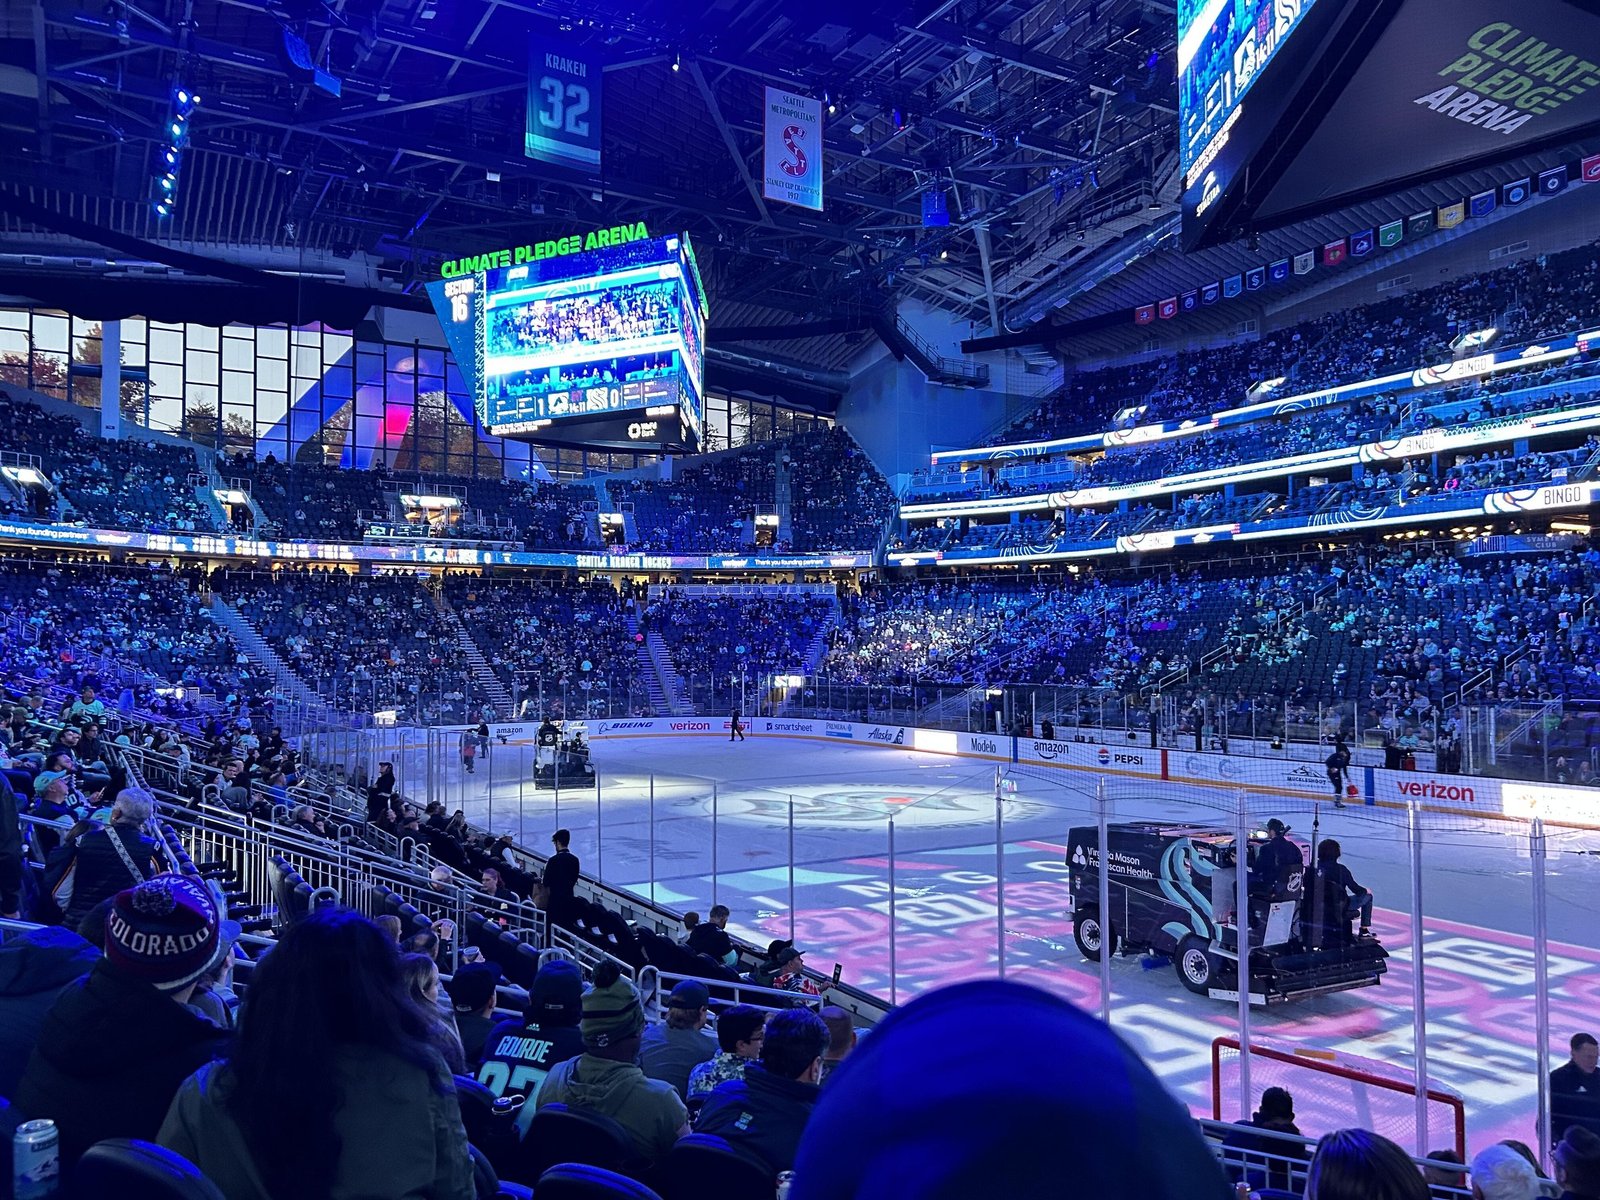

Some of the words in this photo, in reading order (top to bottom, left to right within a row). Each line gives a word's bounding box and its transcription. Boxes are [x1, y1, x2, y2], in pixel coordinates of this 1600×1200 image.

[545, 52, 587, 77] KRAKEN
[1438, 53, 1574, 115] PLEDGE
[539, 76, 590, 136] 32
[782, 95, 805, 108] SEATTLE
[771, 104, 816, 123] METROPOLITANS
[1413, 86, 1533, 135] ARENA
[766, 178, 785, 188] STANLEY
[784, 182, 794, 190] CUP
[787, 191, 799, 200] 1917
[441, 249, 510, 278] CLIMATE
[514, 234, 582, 264] PLEDGE
[585, 221, 649, 250] ARENA
[445, 278, 474, 297] SECTION
[451, 293, 468, 322] 16
[1458, 357, 1487, 375] BINGO
[1406, 436, 1435, 453] BINGO
[1544, 486, 1581, 505] BINGO
[27, 527, 58, 538] founding
[780, 559, 803, 567] founding
[496, 727, 524, 735] amazon
[611, 721, 653, 729] BOEING
[669, 720, 710, 731] verizon
[774, 722, 813, 732] smartsheet
[825, 722, 847, 731] PREMERA
[868, 727, 893, 741] Alaska
[970, 737, 997, 753] Modelo
[1033, 740, 1069, 755] amazon
[1114, 754, 1143, 766] PEPSI
[1396, 780, 1475, 802] verizon
[1115, 852, 1140, 866] Mason
[1126, 865, 1153, 879] Health
[494, 1035, 554, 1063] GOURDE
